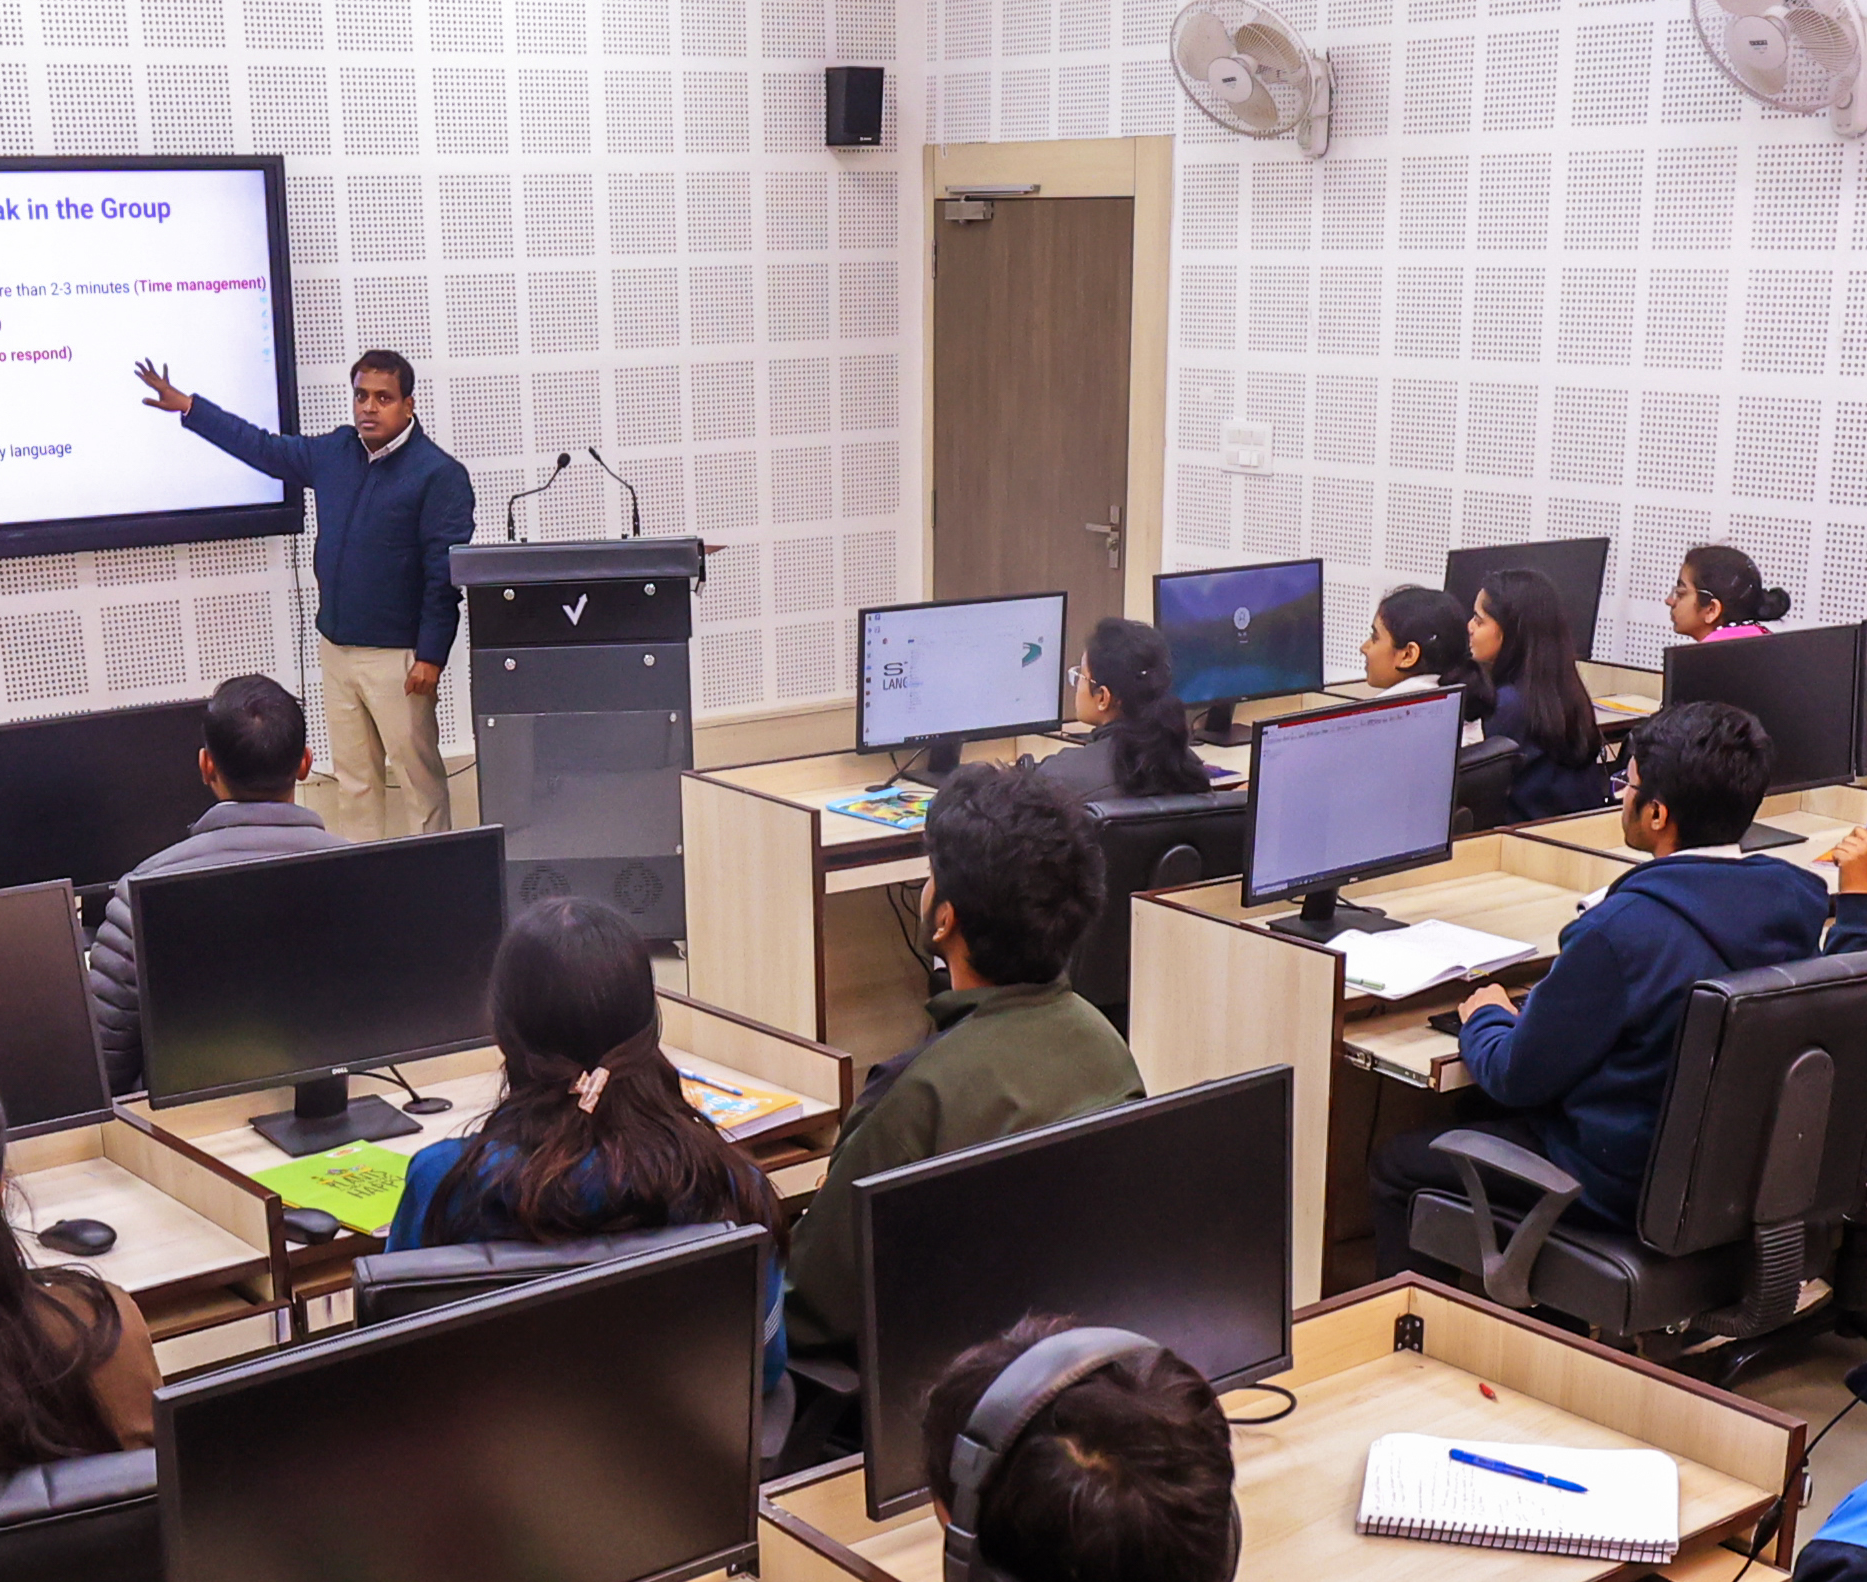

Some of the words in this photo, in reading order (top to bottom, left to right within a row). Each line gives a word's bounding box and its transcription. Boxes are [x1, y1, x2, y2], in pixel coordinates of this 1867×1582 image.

[27, 197, 49, 221] in
[55, 196, 94, 220] the
[100, 197, 171, 224] Group
[15, 282, 47, 297] than
[50, 281, 72, 296] 2-3
[75, 281, 130, 295] minutes
[133, 279, 173, 296] (Time
[176, 276, 266, 294] management)
[10, 345, 73, 364] respond)
[10, 443, 73, 460] language
[884, 661, 908, 676] S
